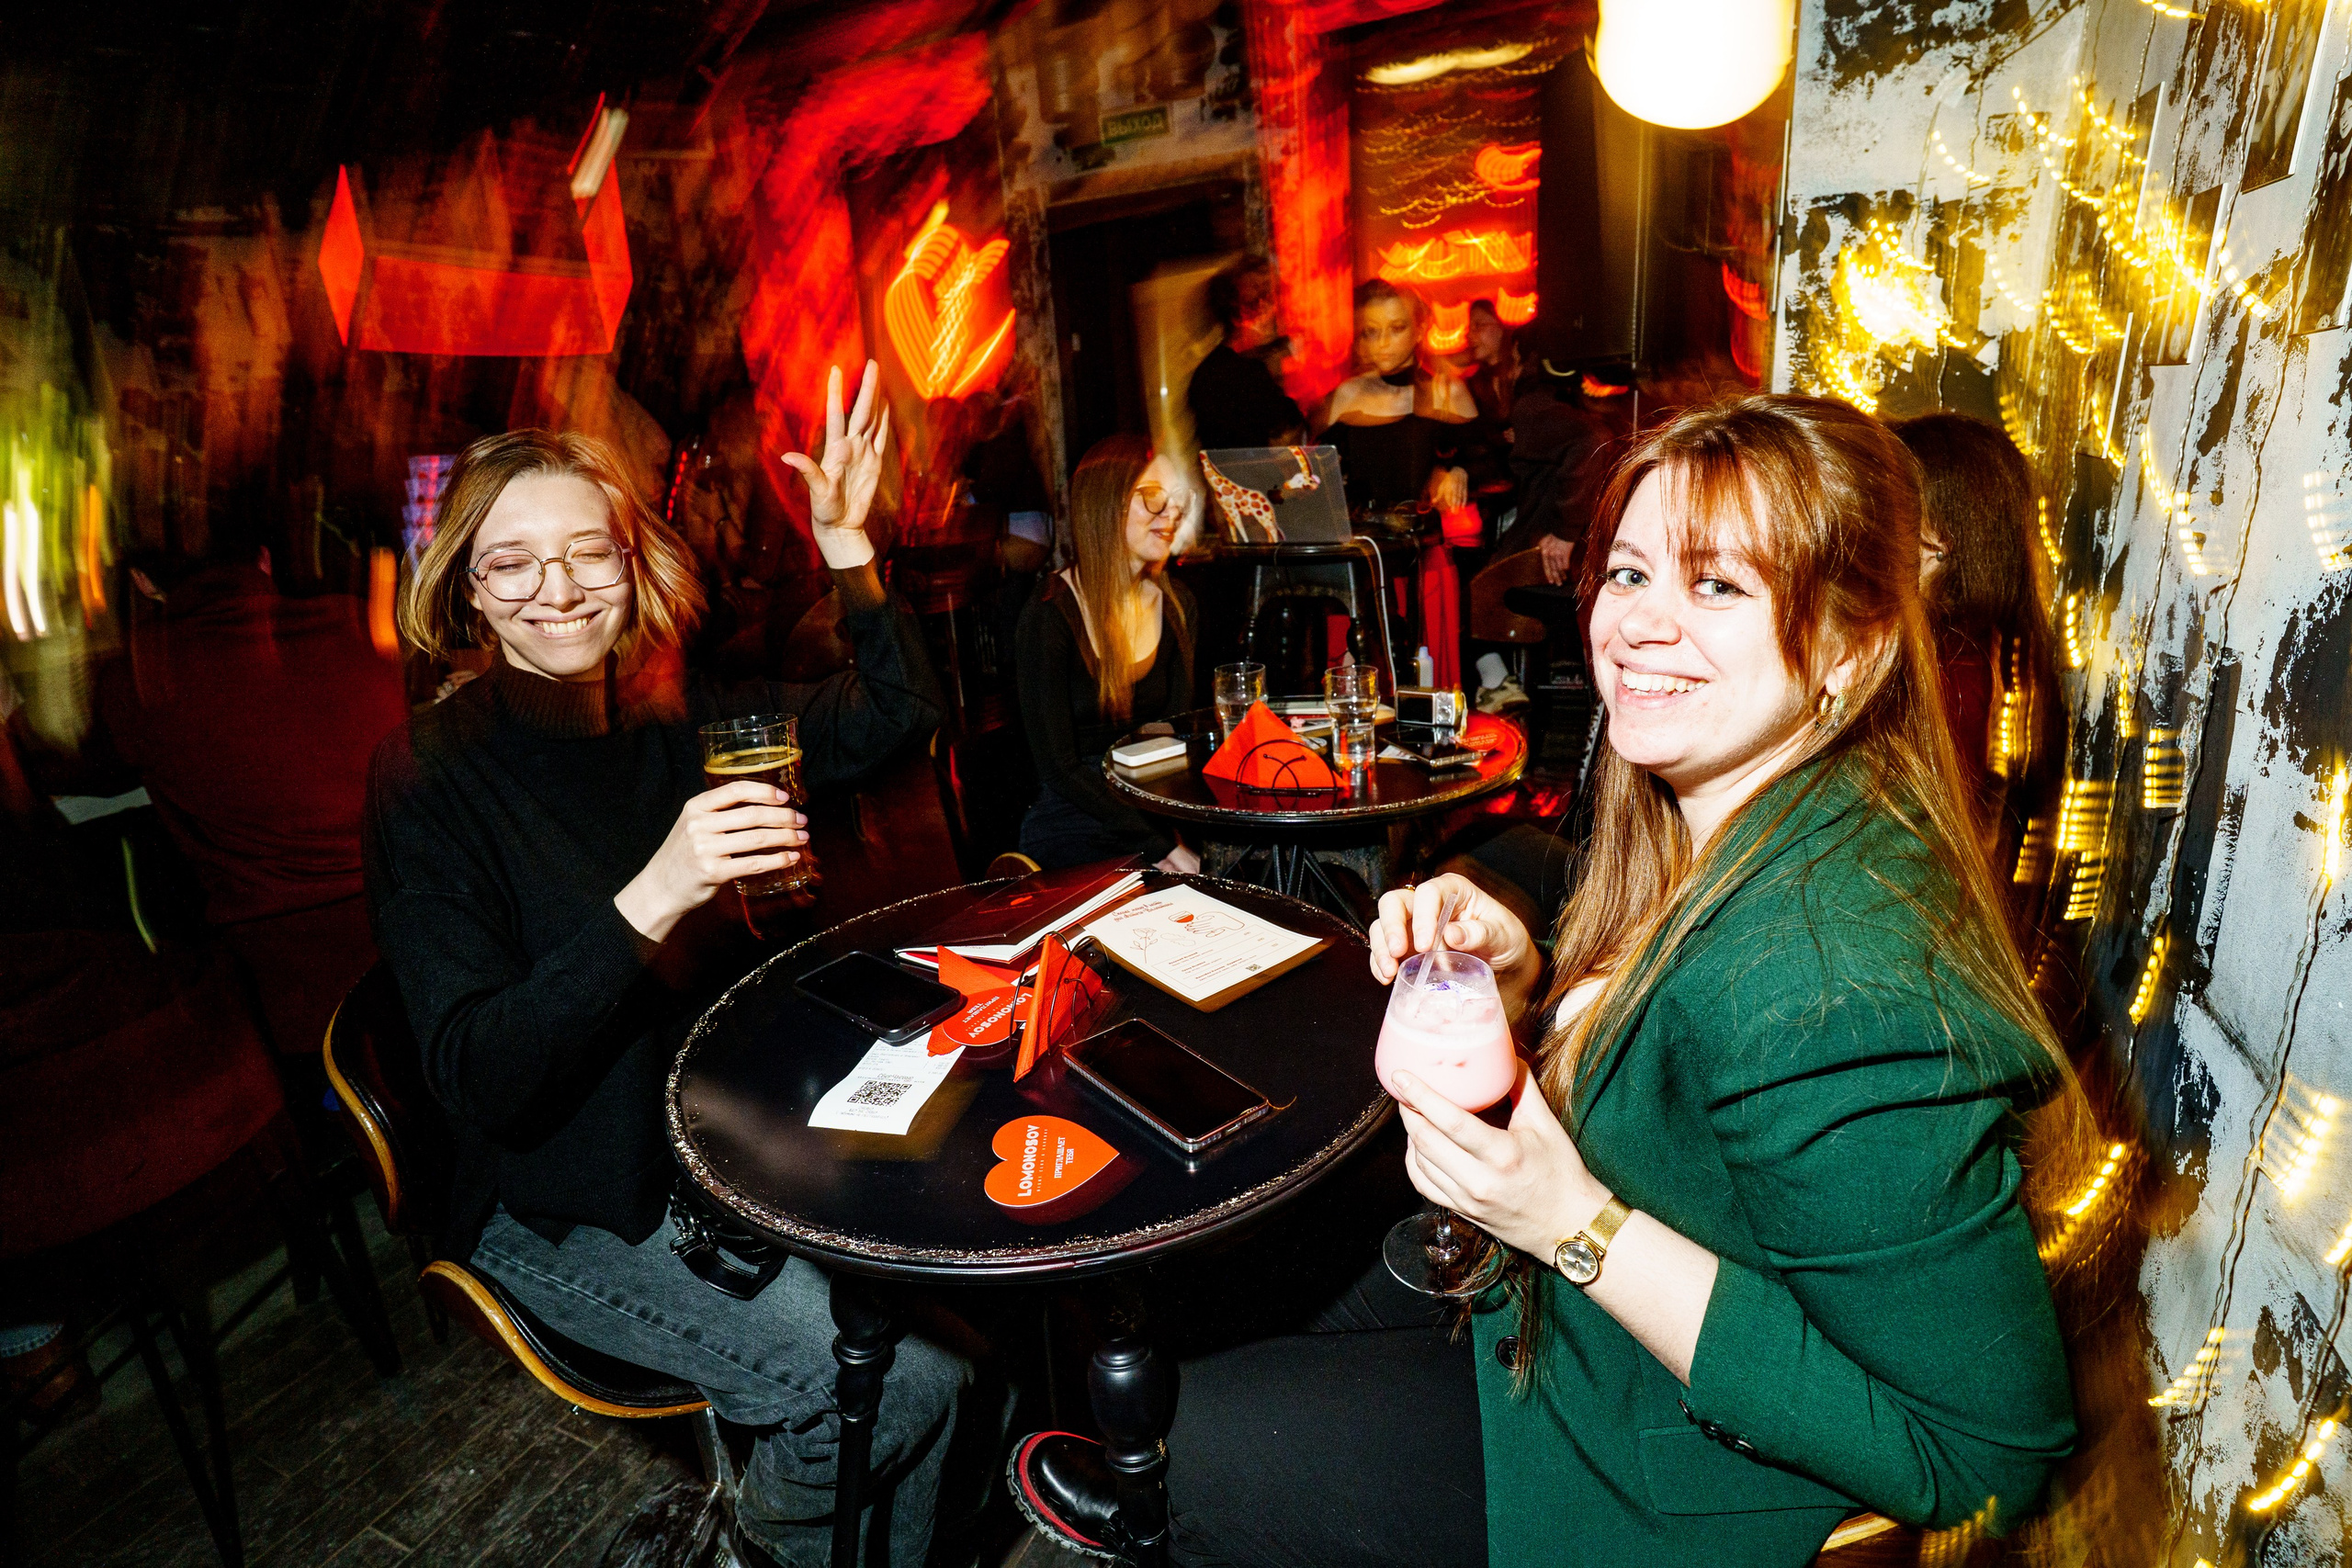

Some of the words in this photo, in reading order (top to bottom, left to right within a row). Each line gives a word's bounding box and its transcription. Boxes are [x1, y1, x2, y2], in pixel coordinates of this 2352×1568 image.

[1107, 112, 1165, 138] ВЫХОД
[968, 992, 1033, 1039] LOMONOSOV
[1017, 1124, 1041, 1197] LOMONOSOV
[1054, 1136, 1066, 1179] ПРИГЛАШАЕТ
[1066, 1148, 1075, 1165] ТЕБЯ
